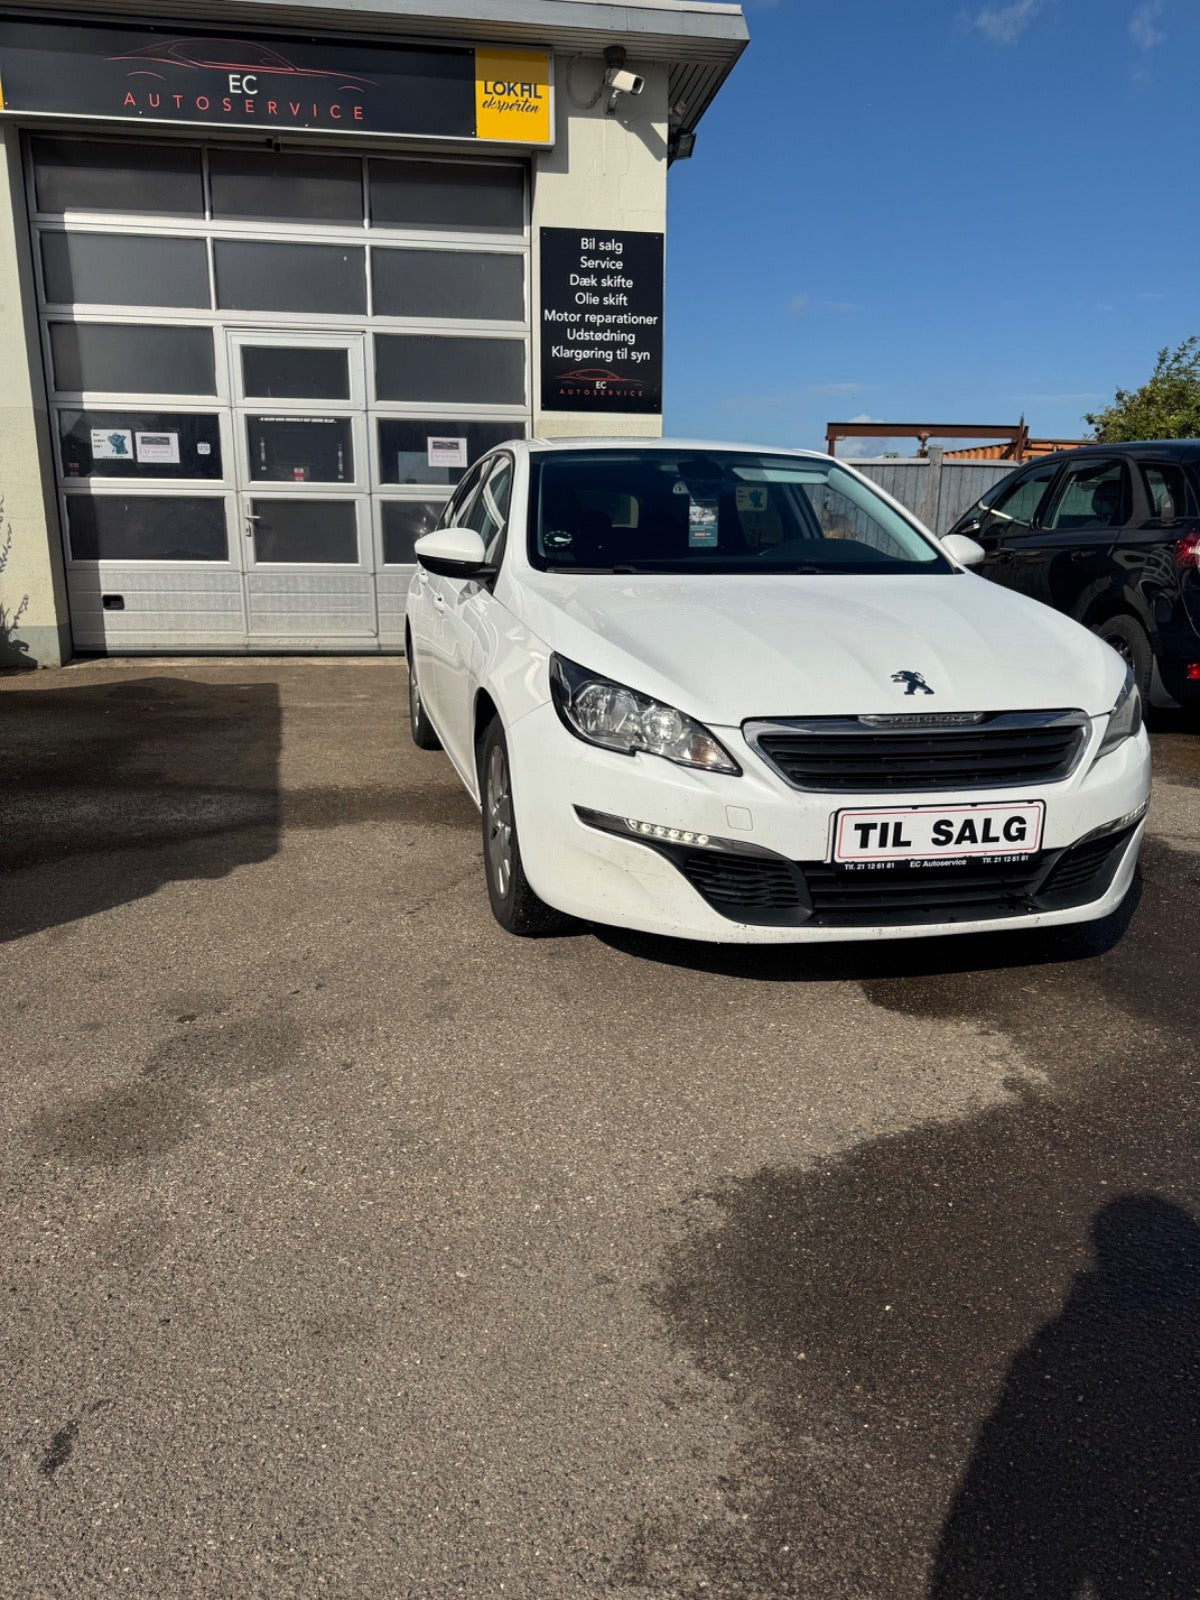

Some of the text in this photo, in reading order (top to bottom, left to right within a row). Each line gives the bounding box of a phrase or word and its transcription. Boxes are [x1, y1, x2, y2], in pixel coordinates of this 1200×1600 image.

[228, 74, 259, 95] EC
[483, 80, 543, 99] LOKAL
[123, 92, 364, 120] AUTOSERVICE
[482, 97, 540, 114] eksperten
[580, 237, 623, 254] Bil salg
[580, 256, 624, 270] Service
[569, 274, 634, 288] Dæk skifte
[575, 292, 629, 306] Olie skift
[544, 309, 658, 326] Motor reparationer
[567, 328, 636, 345] Udstødning
[551, 346, 651, 363] Klargøring til syn
[560, 388, 643, 397] AUTOSERVICE
[595, 381, 607, 389] EC
[854, 815, 1027, 849] TIL SALG
[922, 859, 967, 868] Autoservice
